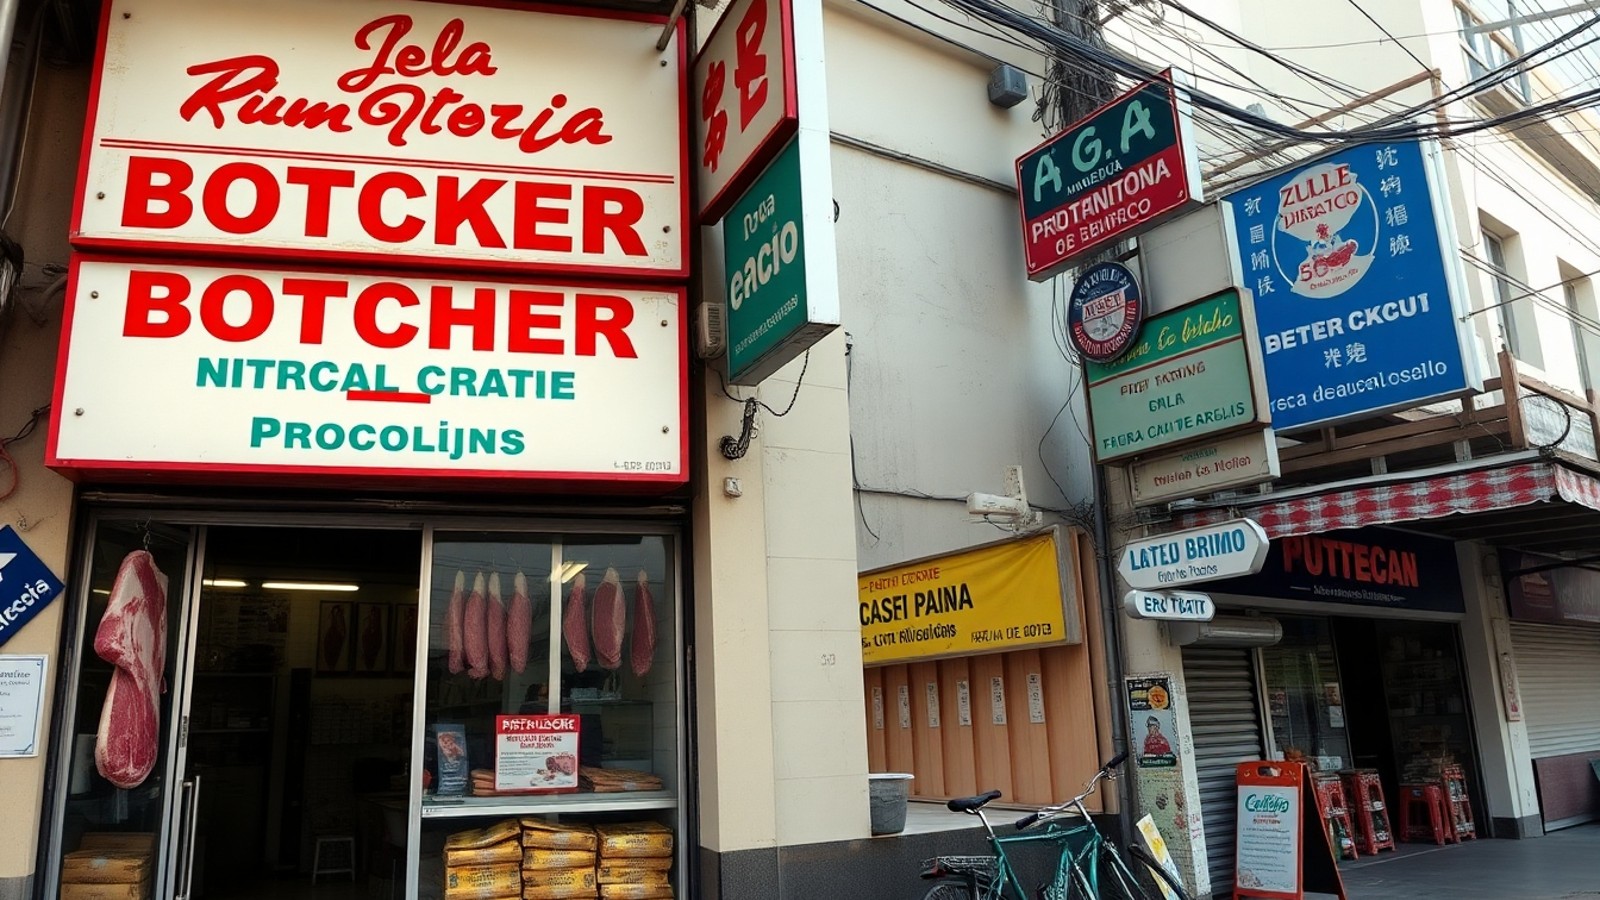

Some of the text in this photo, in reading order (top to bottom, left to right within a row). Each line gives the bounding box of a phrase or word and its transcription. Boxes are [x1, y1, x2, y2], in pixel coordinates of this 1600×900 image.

[337, 14, 498, 93] Jela
[121, 156, 649, 257] BOTCKER
[122, 269, 639, 359] BOTCHER
[1264, 317, 1345, 355] BETER
[196, 357, 576, 400] NITRCAL CRATIE
[914, 583, 974, 618] PAINA
